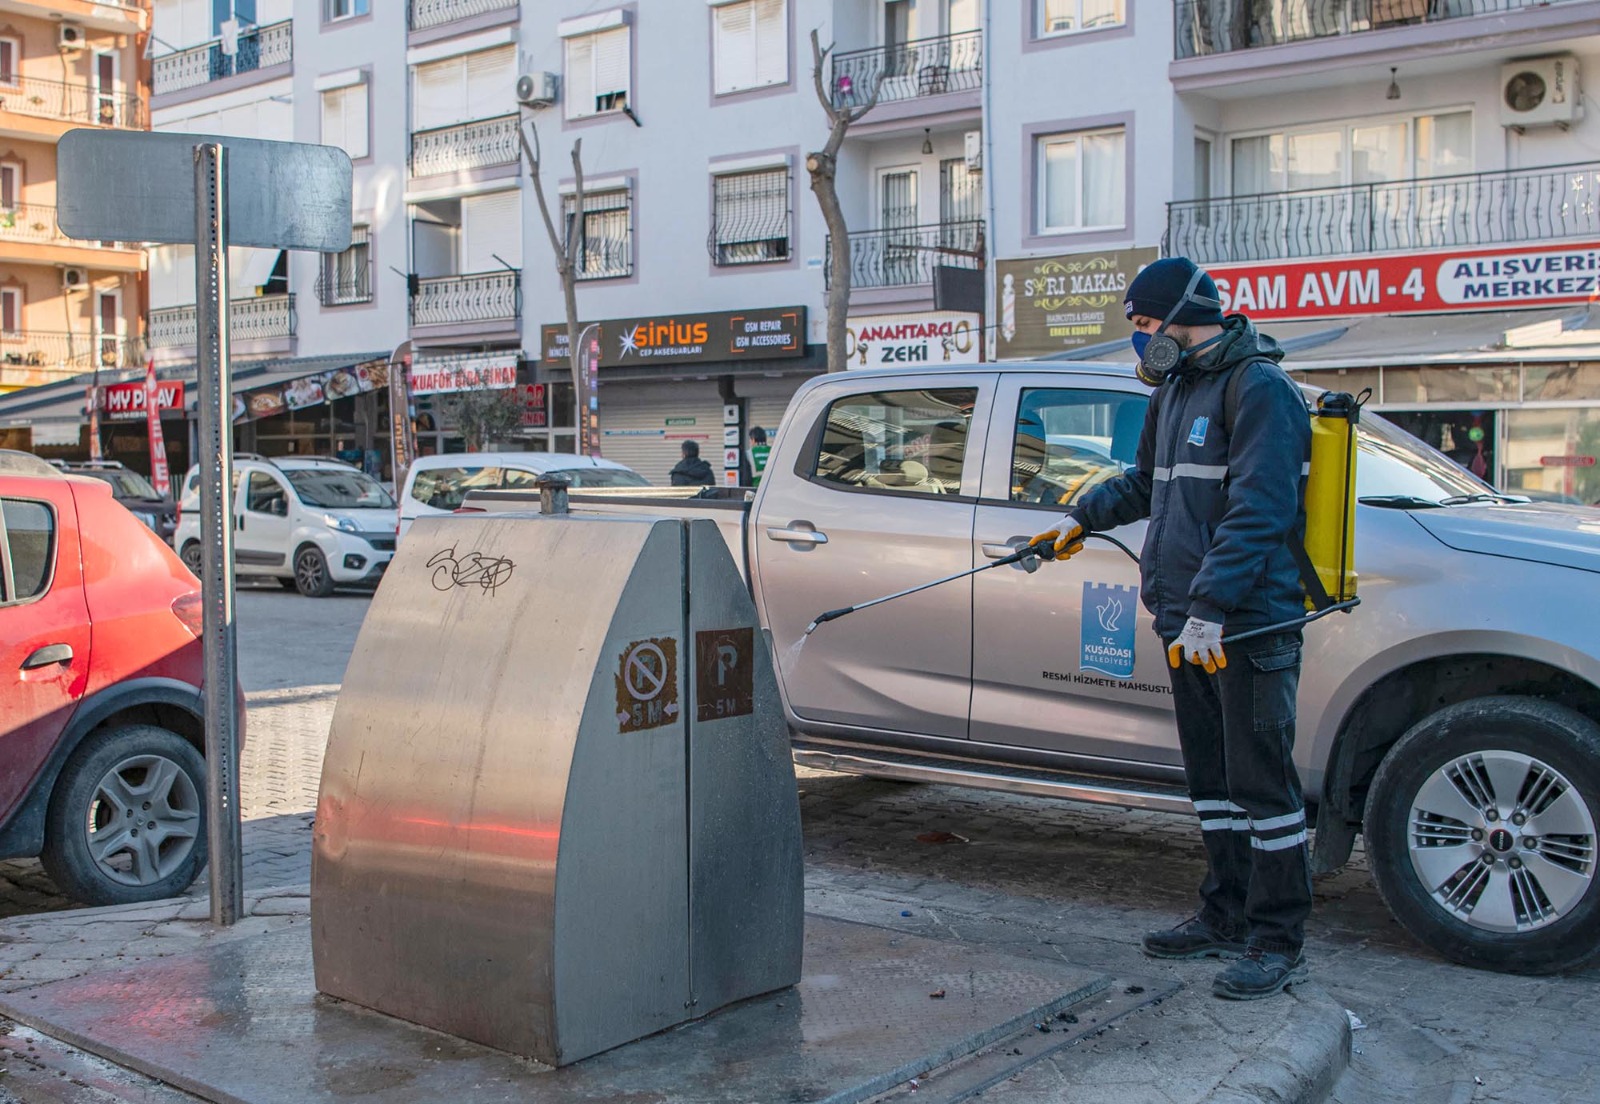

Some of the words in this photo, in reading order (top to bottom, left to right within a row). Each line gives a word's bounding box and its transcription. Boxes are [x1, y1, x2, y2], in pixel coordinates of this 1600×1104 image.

[1453, 252, 1600, 279] ALIŞVERİ
[1071, 273, 1127, 294] MAKAS
[1297, 268, 1381, 308] AVM
[1463, 275, 1600, 300] MERKEZ
[634, 319, 709, 347] sirius
[744, 322, 758, 333] GSM
[760, 320, 782, 332] REPAIR
[639, 348, 653, 357] CEP
[654, 347, 703, 356] AKSESUARLARI
[736, 336, 750, 348] GSM
[752, 334, 792, 347] ACCESSORIES
[881, 340, 928, 363] ZEKİ
[108, 389, 131, 410] MY
[133, 384, 176, 408] PİAV
[1101, 636, 1116, 645] T.C.
[1042, 670, 1071, 682] RESMİ
[1073, 674, 1116, 688] HİZMETE
